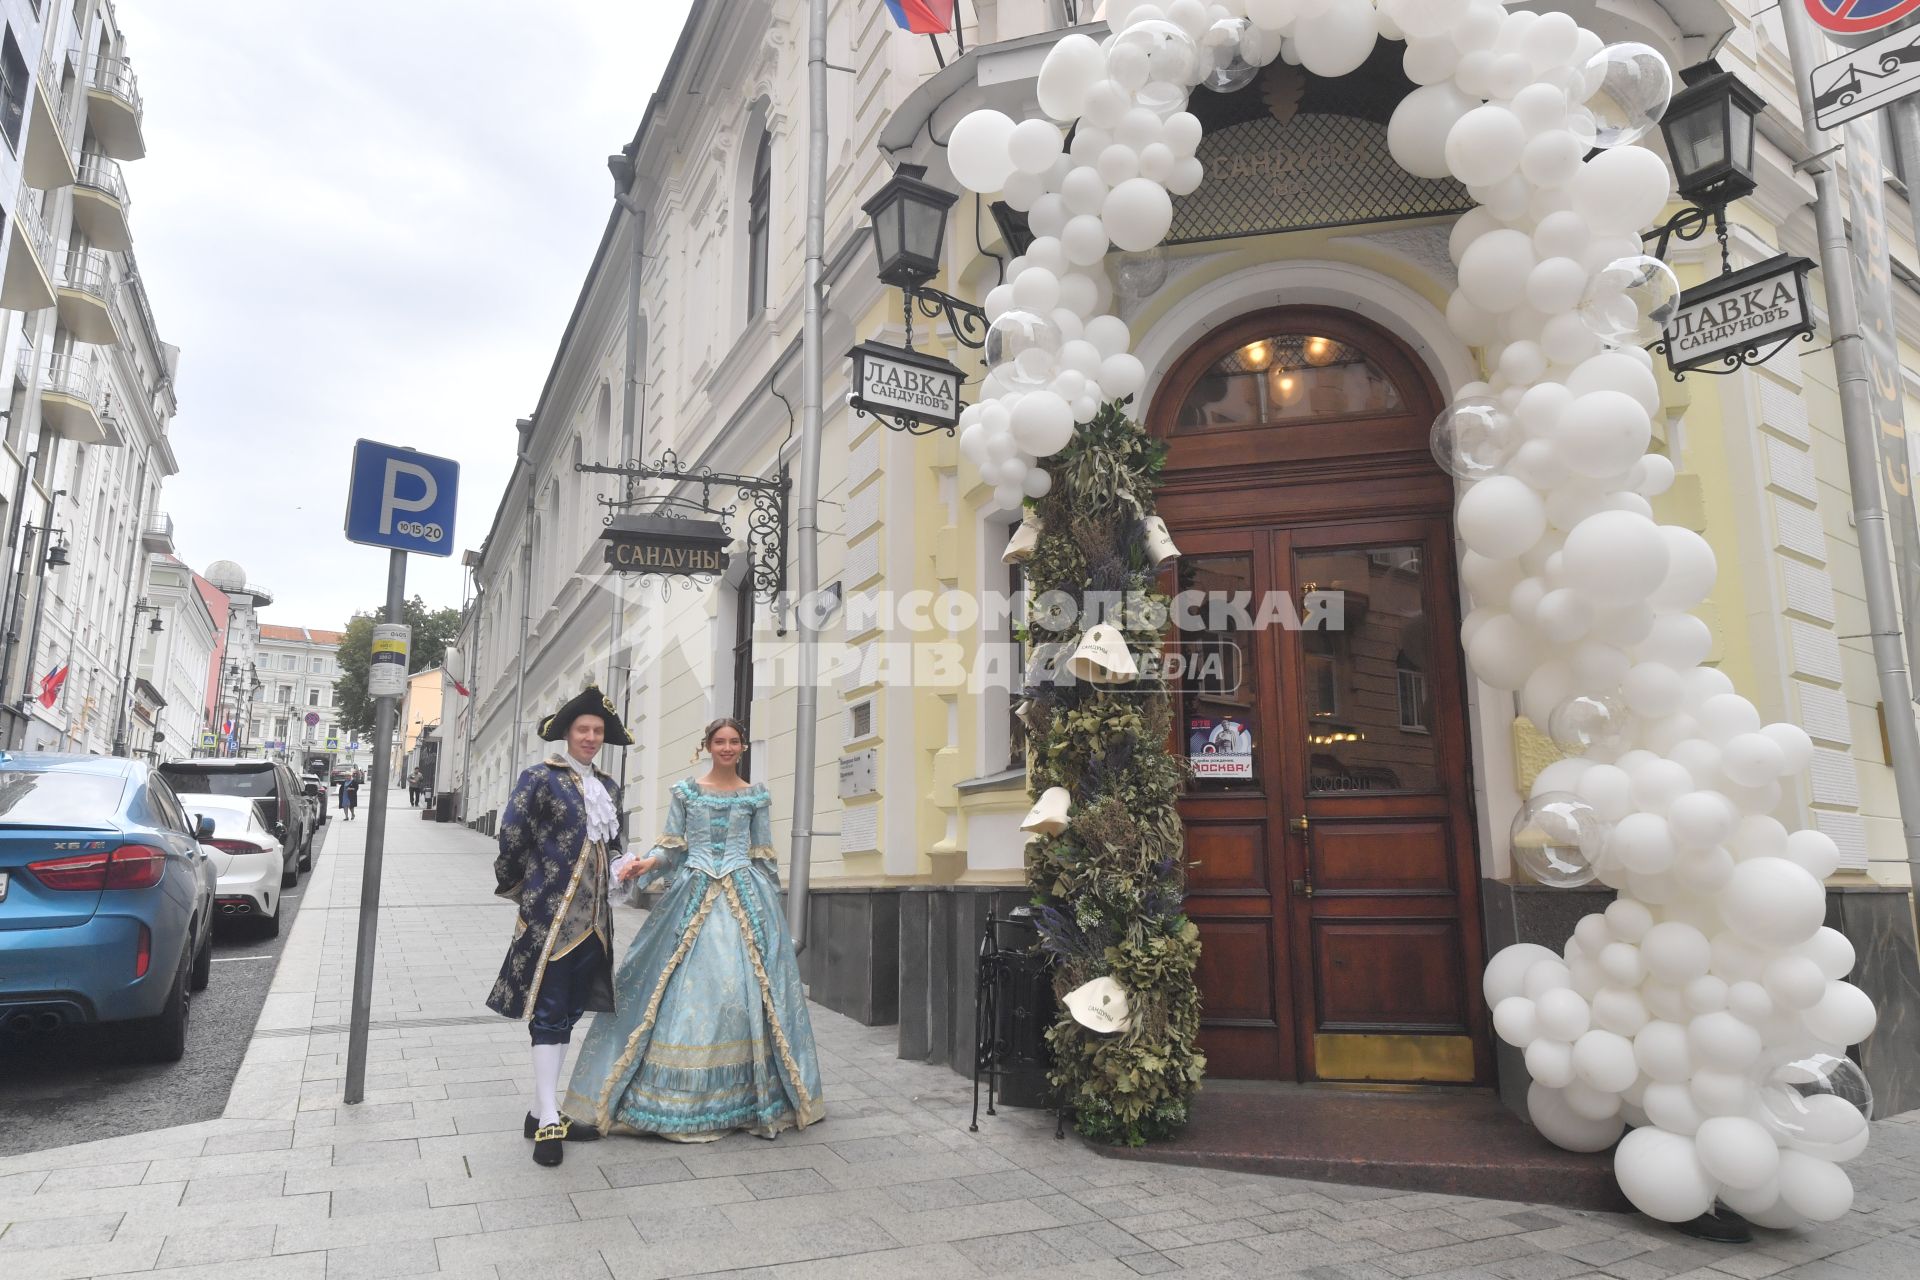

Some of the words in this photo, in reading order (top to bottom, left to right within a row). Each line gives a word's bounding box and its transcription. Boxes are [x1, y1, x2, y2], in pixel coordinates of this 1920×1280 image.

[1670, 281, 1795, 341] ЛАВКА
[1679, 306, 1789, 350] САНДУНОВЪ
[865, 361, 954, 401] ЛАВКА
[871, 383, 949, 411] САНДУНОВЪ
[379, 457, 438, 535] P
[400, 523, 409, 531] 10
[425, 526, 441, 539] 20
[616, 544, 719, 570] САНДУНЫ
[1192, 763, 1250, 773] МОСКВА!
[53, 842, 81, 850] X6
